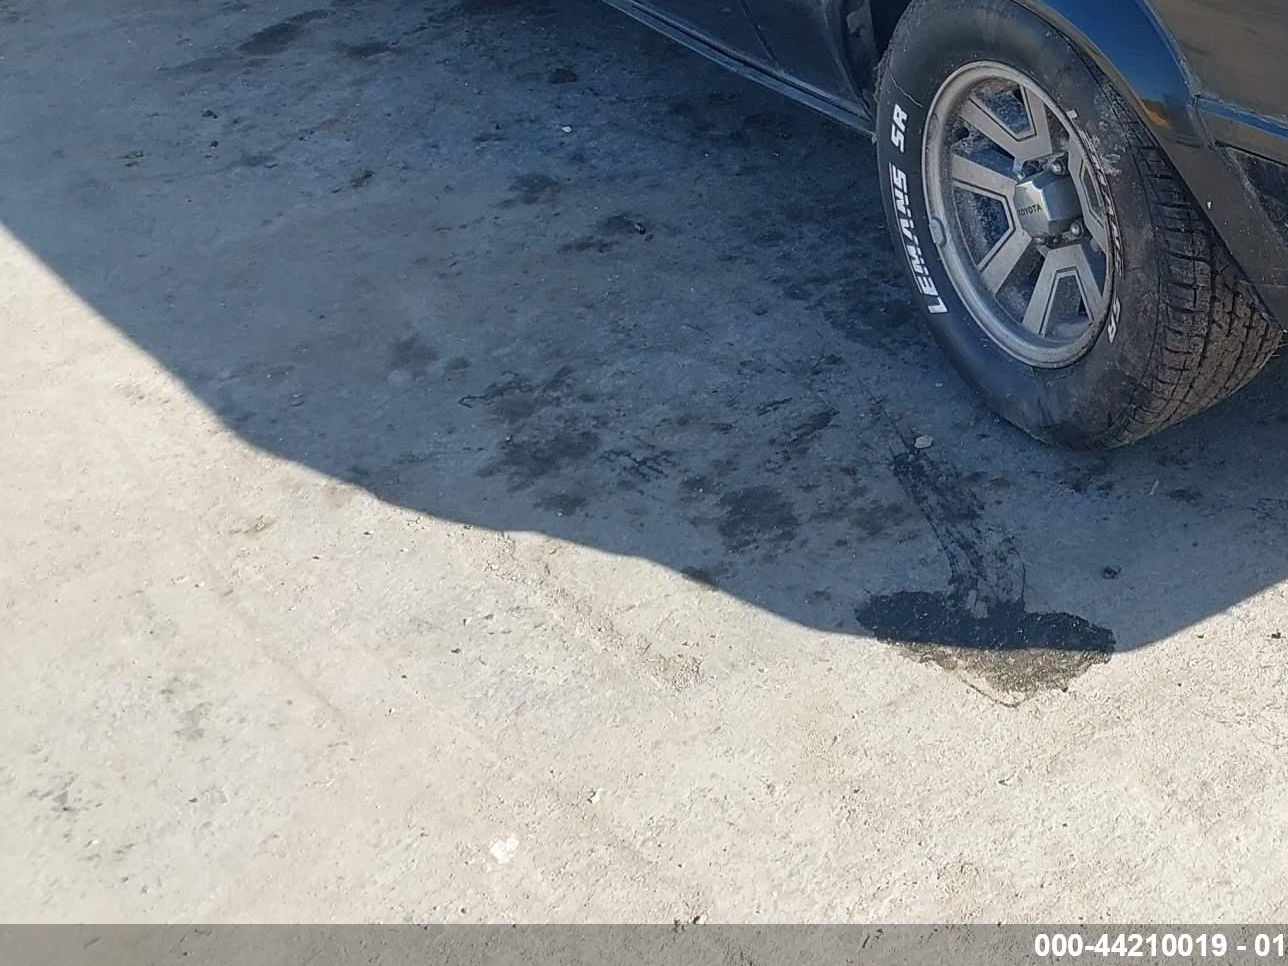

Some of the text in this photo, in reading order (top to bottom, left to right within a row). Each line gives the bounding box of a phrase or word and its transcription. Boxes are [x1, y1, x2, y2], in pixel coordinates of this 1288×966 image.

[889, 103, 949, 314] LEMANS SR
[1016, 203, 1043, 217] TOYOTA
